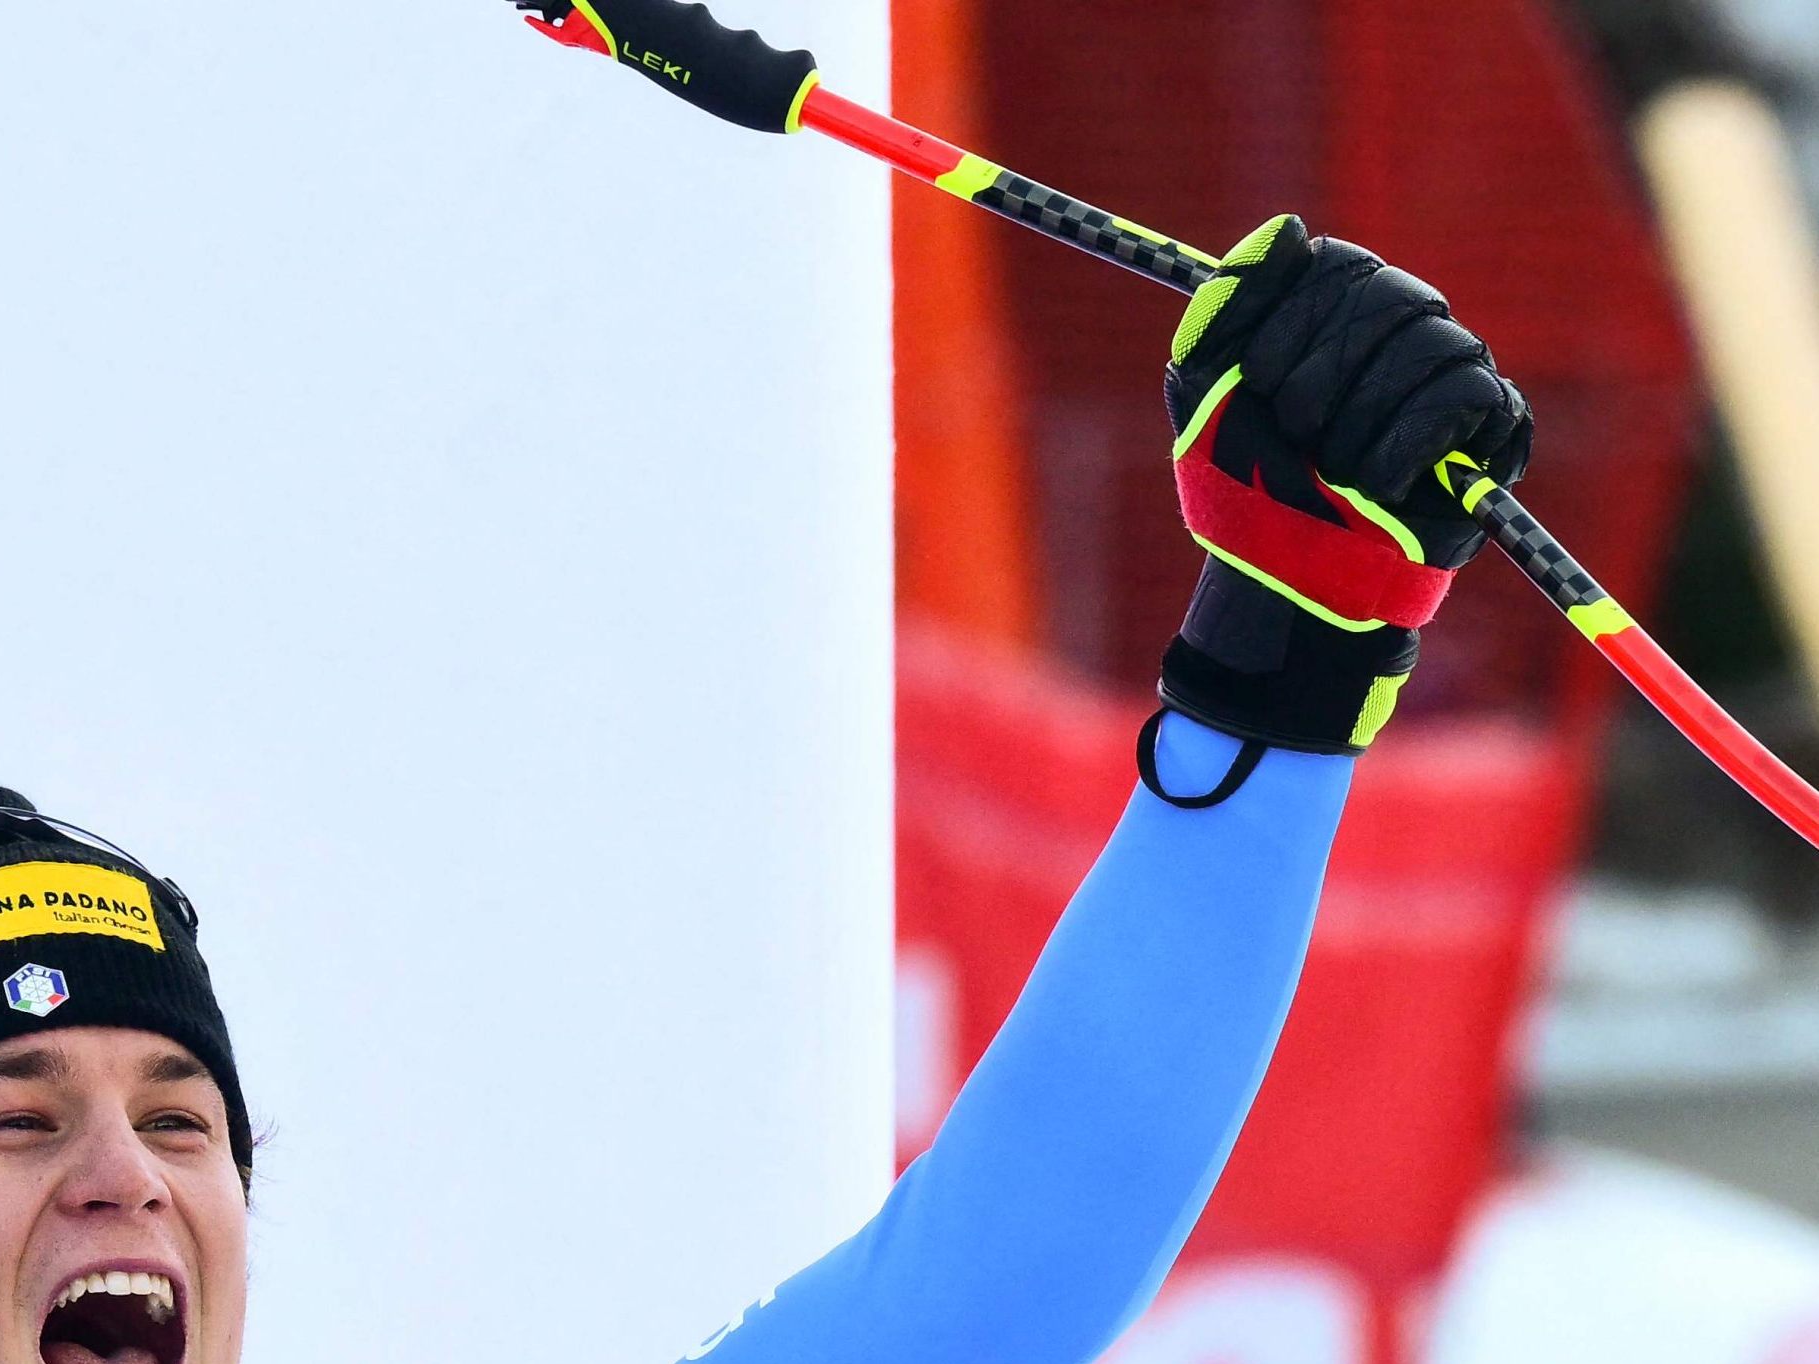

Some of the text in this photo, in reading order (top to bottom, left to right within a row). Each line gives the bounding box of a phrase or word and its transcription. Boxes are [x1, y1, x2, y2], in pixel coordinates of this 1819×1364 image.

[622, 40, 692, 85] LEKI
[44, 891, 148, 922] PADANO
[15, 966, 52, 983] FISI
